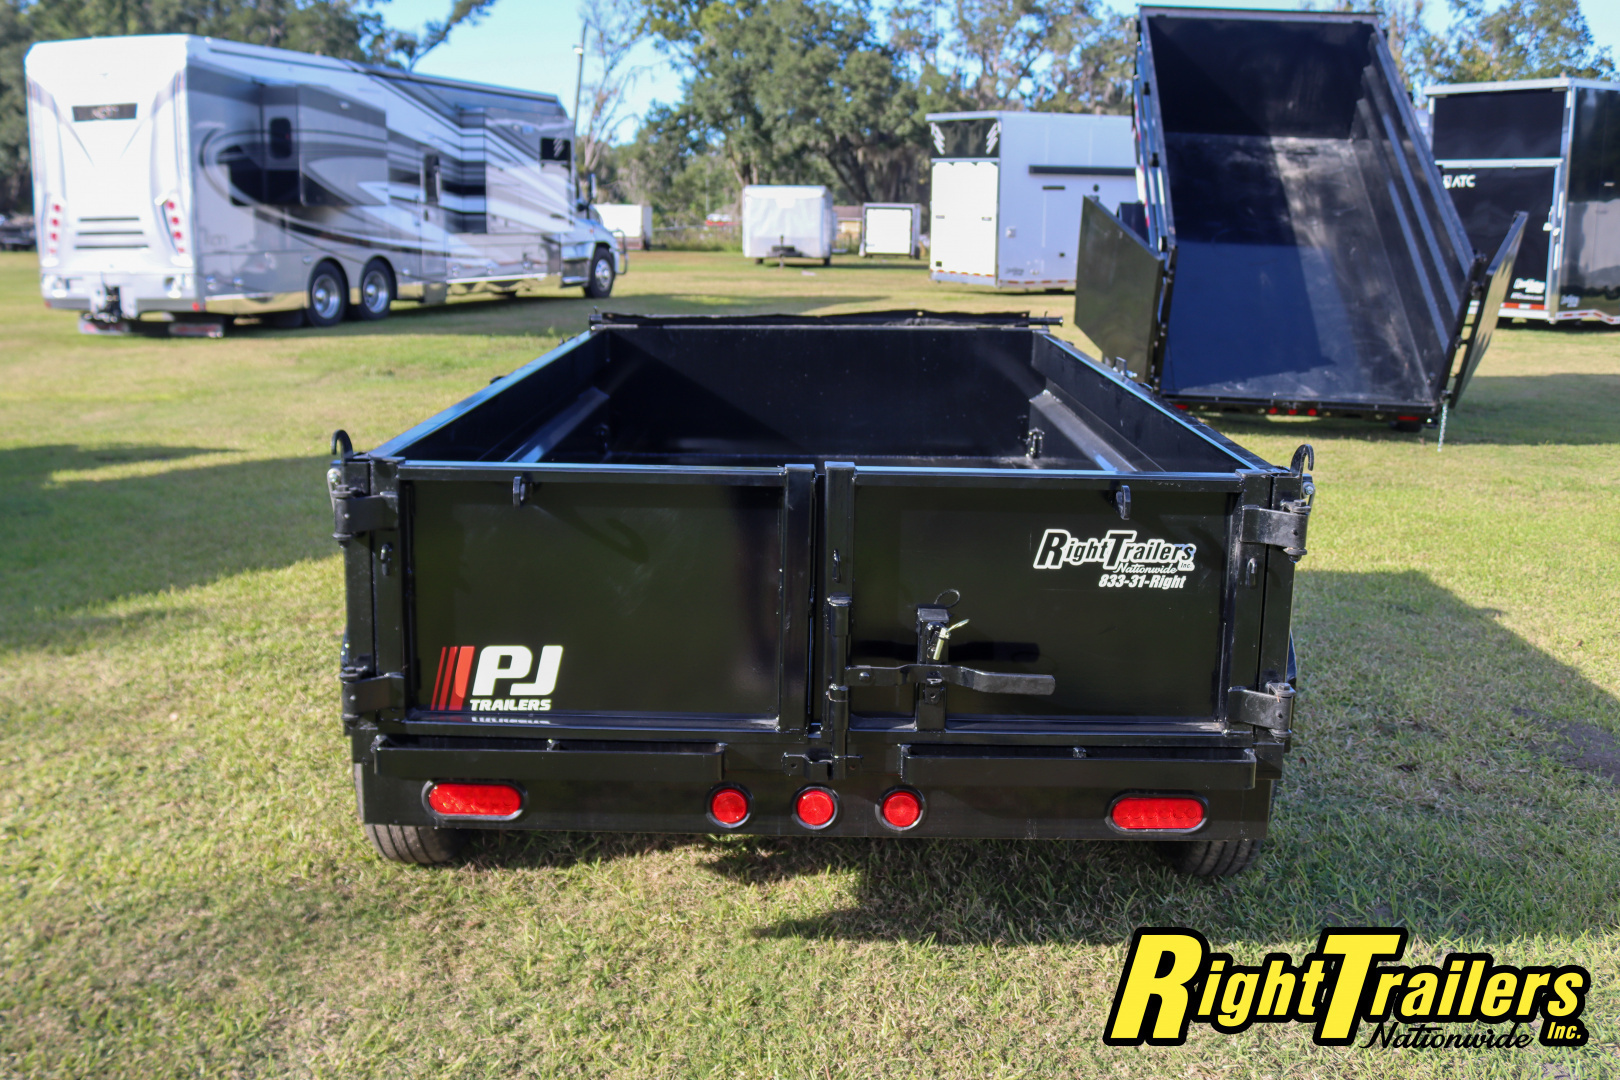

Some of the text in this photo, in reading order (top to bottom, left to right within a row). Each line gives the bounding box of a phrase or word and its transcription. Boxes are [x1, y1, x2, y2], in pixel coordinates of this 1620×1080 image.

[1452, 174, 1476, 188] ATC
[1113, 563, 1177, 574] Nationwide
[1099, 574, 1186, 590] 833-31-Right
[472, 645, 563, 696] PJ
[470, 699, 551, 711] TRAILERS
